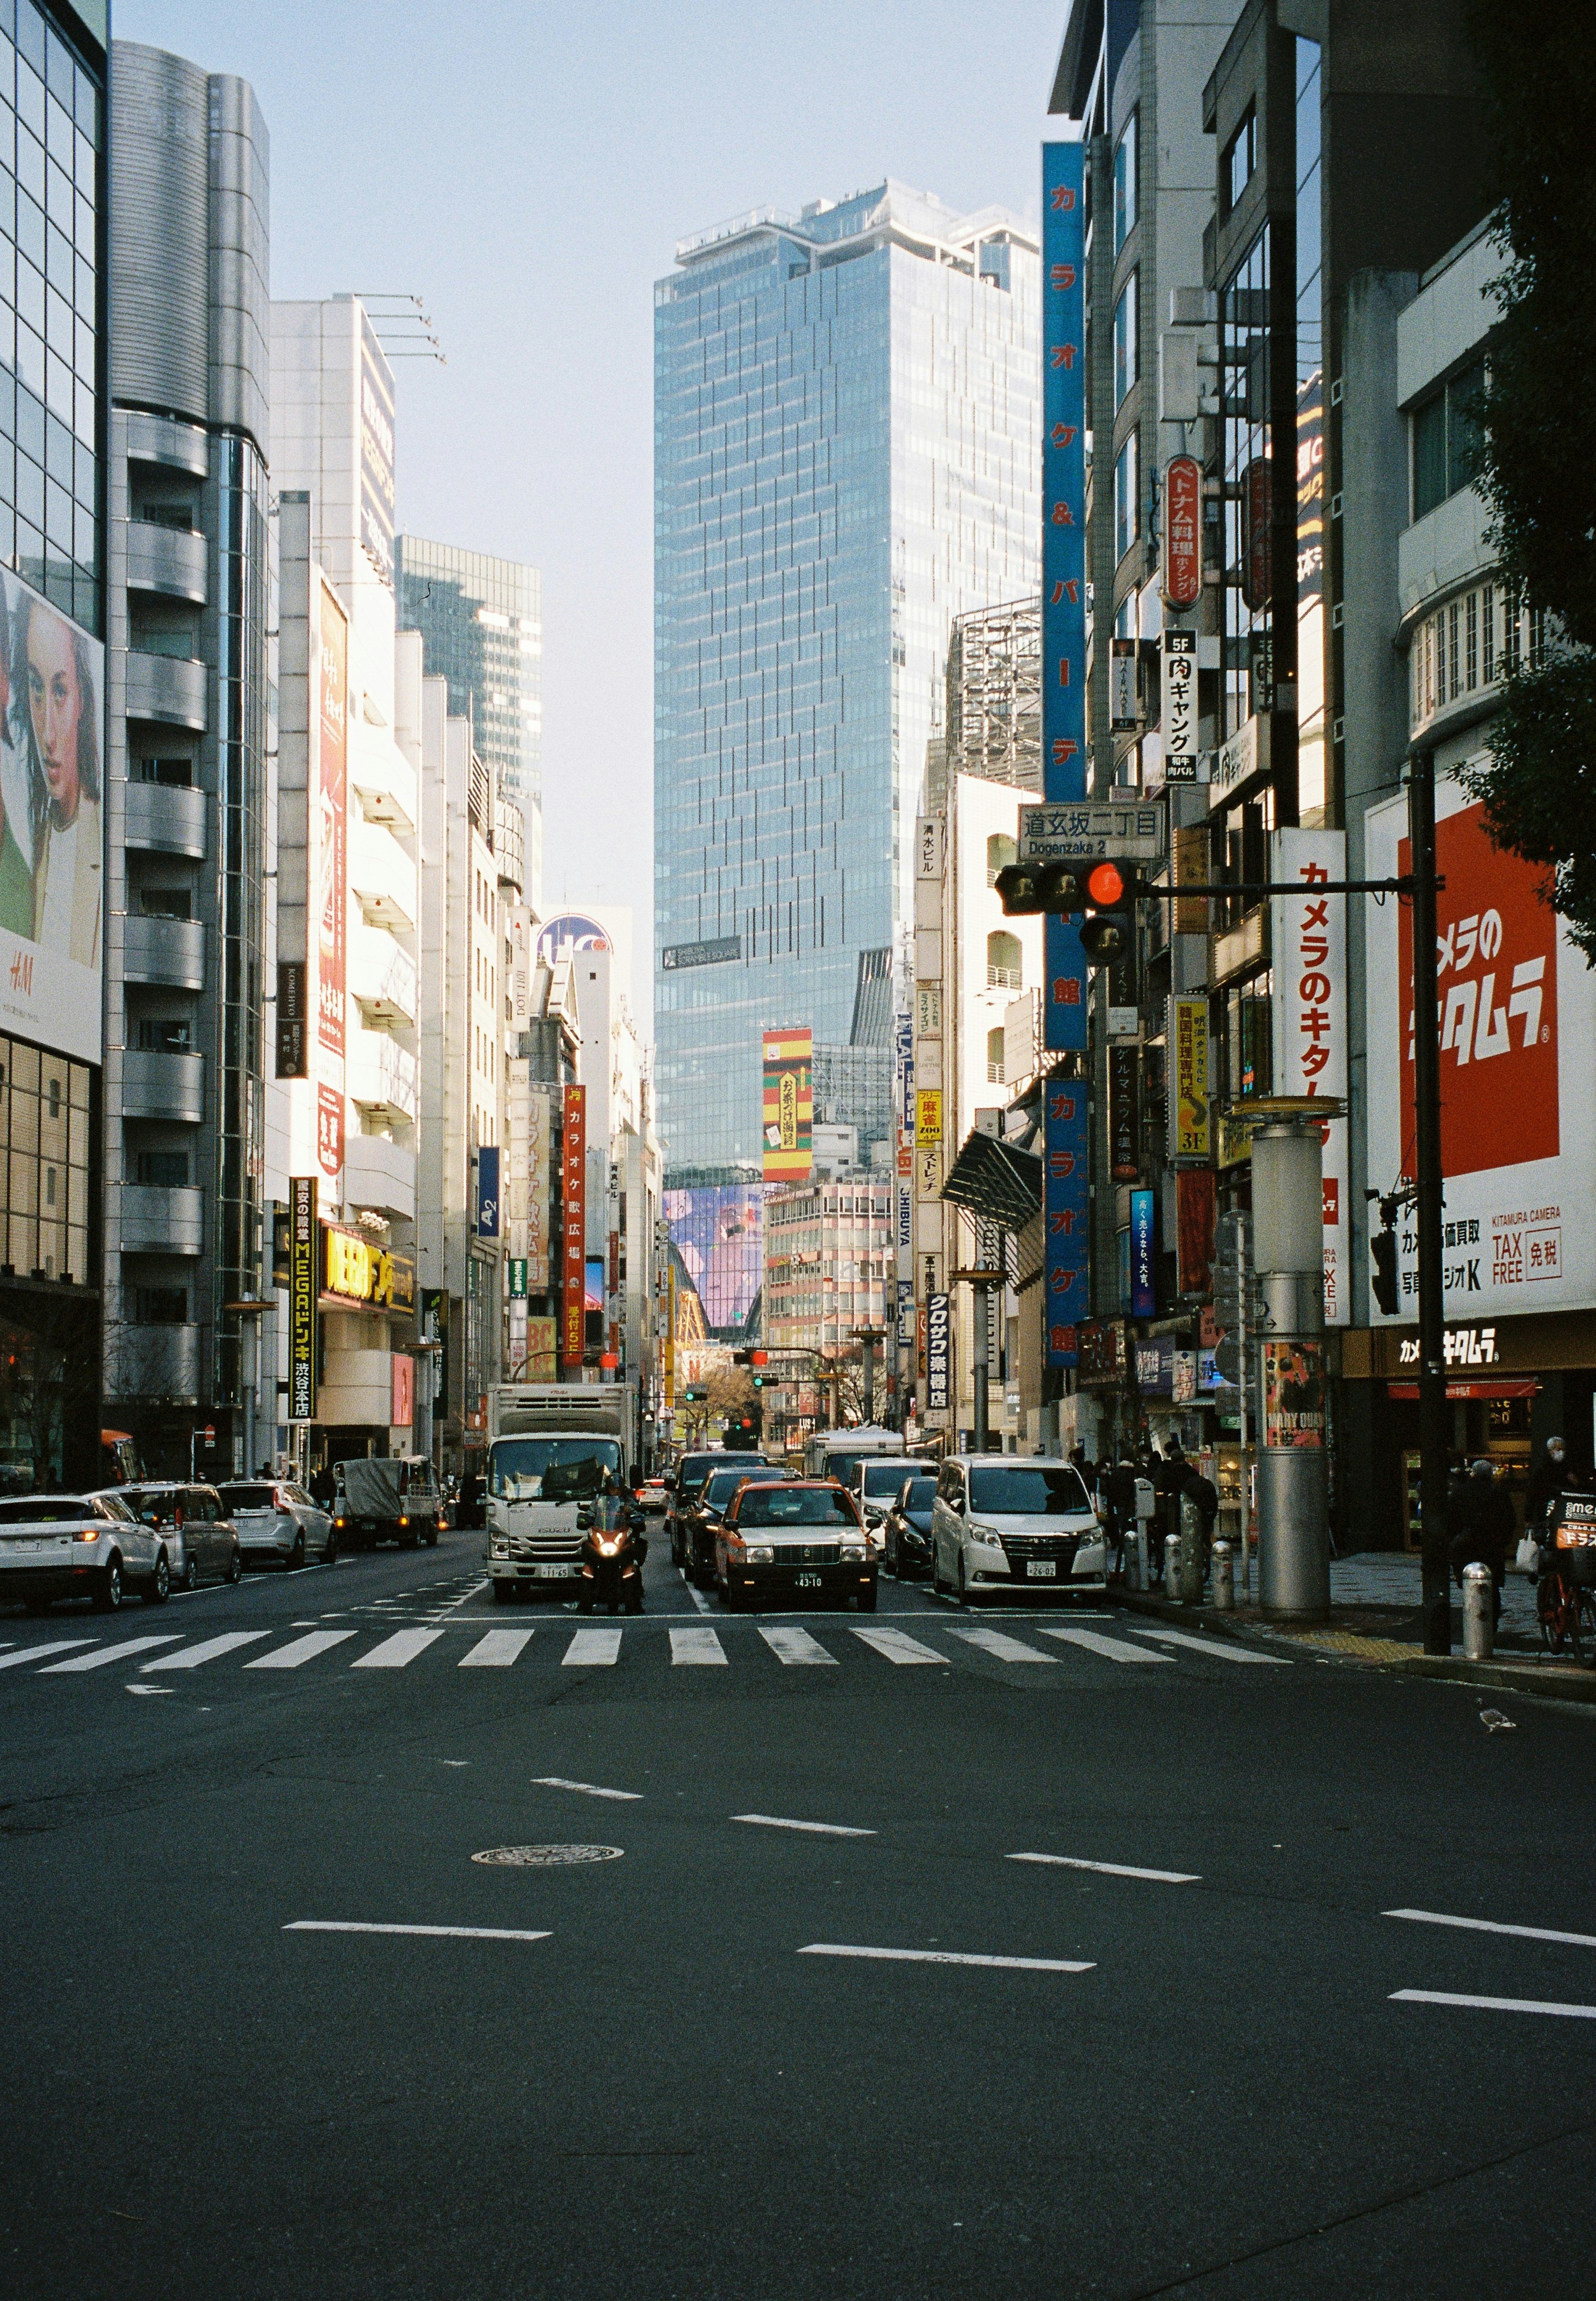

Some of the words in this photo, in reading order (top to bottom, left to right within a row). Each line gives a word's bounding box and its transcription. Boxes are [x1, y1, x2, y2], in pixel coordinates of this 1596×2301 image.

[1172, 465, 1194, 556] ベトナム料理
[1172, 638, 1189, 652] 5F
[1168, 656, 1192, 752] 肉ギャング
[1167, 766, 1194, 776] 肉バル
[1172, 756, 1190, 766] 和牛
[1025, 810, 1157, 837] 道玄坂二丁目
[923, 824, 934, 872] 清水ビル
[1029, 841, 1093, 855] Dogenzaka
[1098, 841, 1106, 854] 2
[517, 993, 525, 1015] DOT
[1180, 1006, 1193, 1099] 韓国料理専門店
[922, 1101, 937, 1126] 麻雀
[1116, 1048, 1131, 1162] ゲルマニウム温浴
[1182, 1132, 1205, 1150] 3F
[568, 1111, 580, 1259] カラオケ歌広場
[922, 1153, 938, 1192] ストレッチ
[900, 1187, 910, 1246] SHIBUYA
[1050, 1094, 1077, 1353] カラオケ館
[1492, 1212, 1527, 1228] KITAMURA
[1530, 1206, 1561, 1222] CAMERA
[1139, 1199, 1149, 1287] 高く売るなら、大吉。
[1492, 1232, 1522, 1260] TAX
[1530, 1239, 1557, 1267] 免税
[1493, 1260, 1522, 1285] FREE
[296, 1242, 310, 1360] MEGAドンキ
[930, 1295, 947, 1407] クロサワ楽器店
[296, 1363, 309, 1416] 渋谷本店
[1268, 1412, 1298, 1428] MARY
[799, 1578, 822, 1587] 43-10
